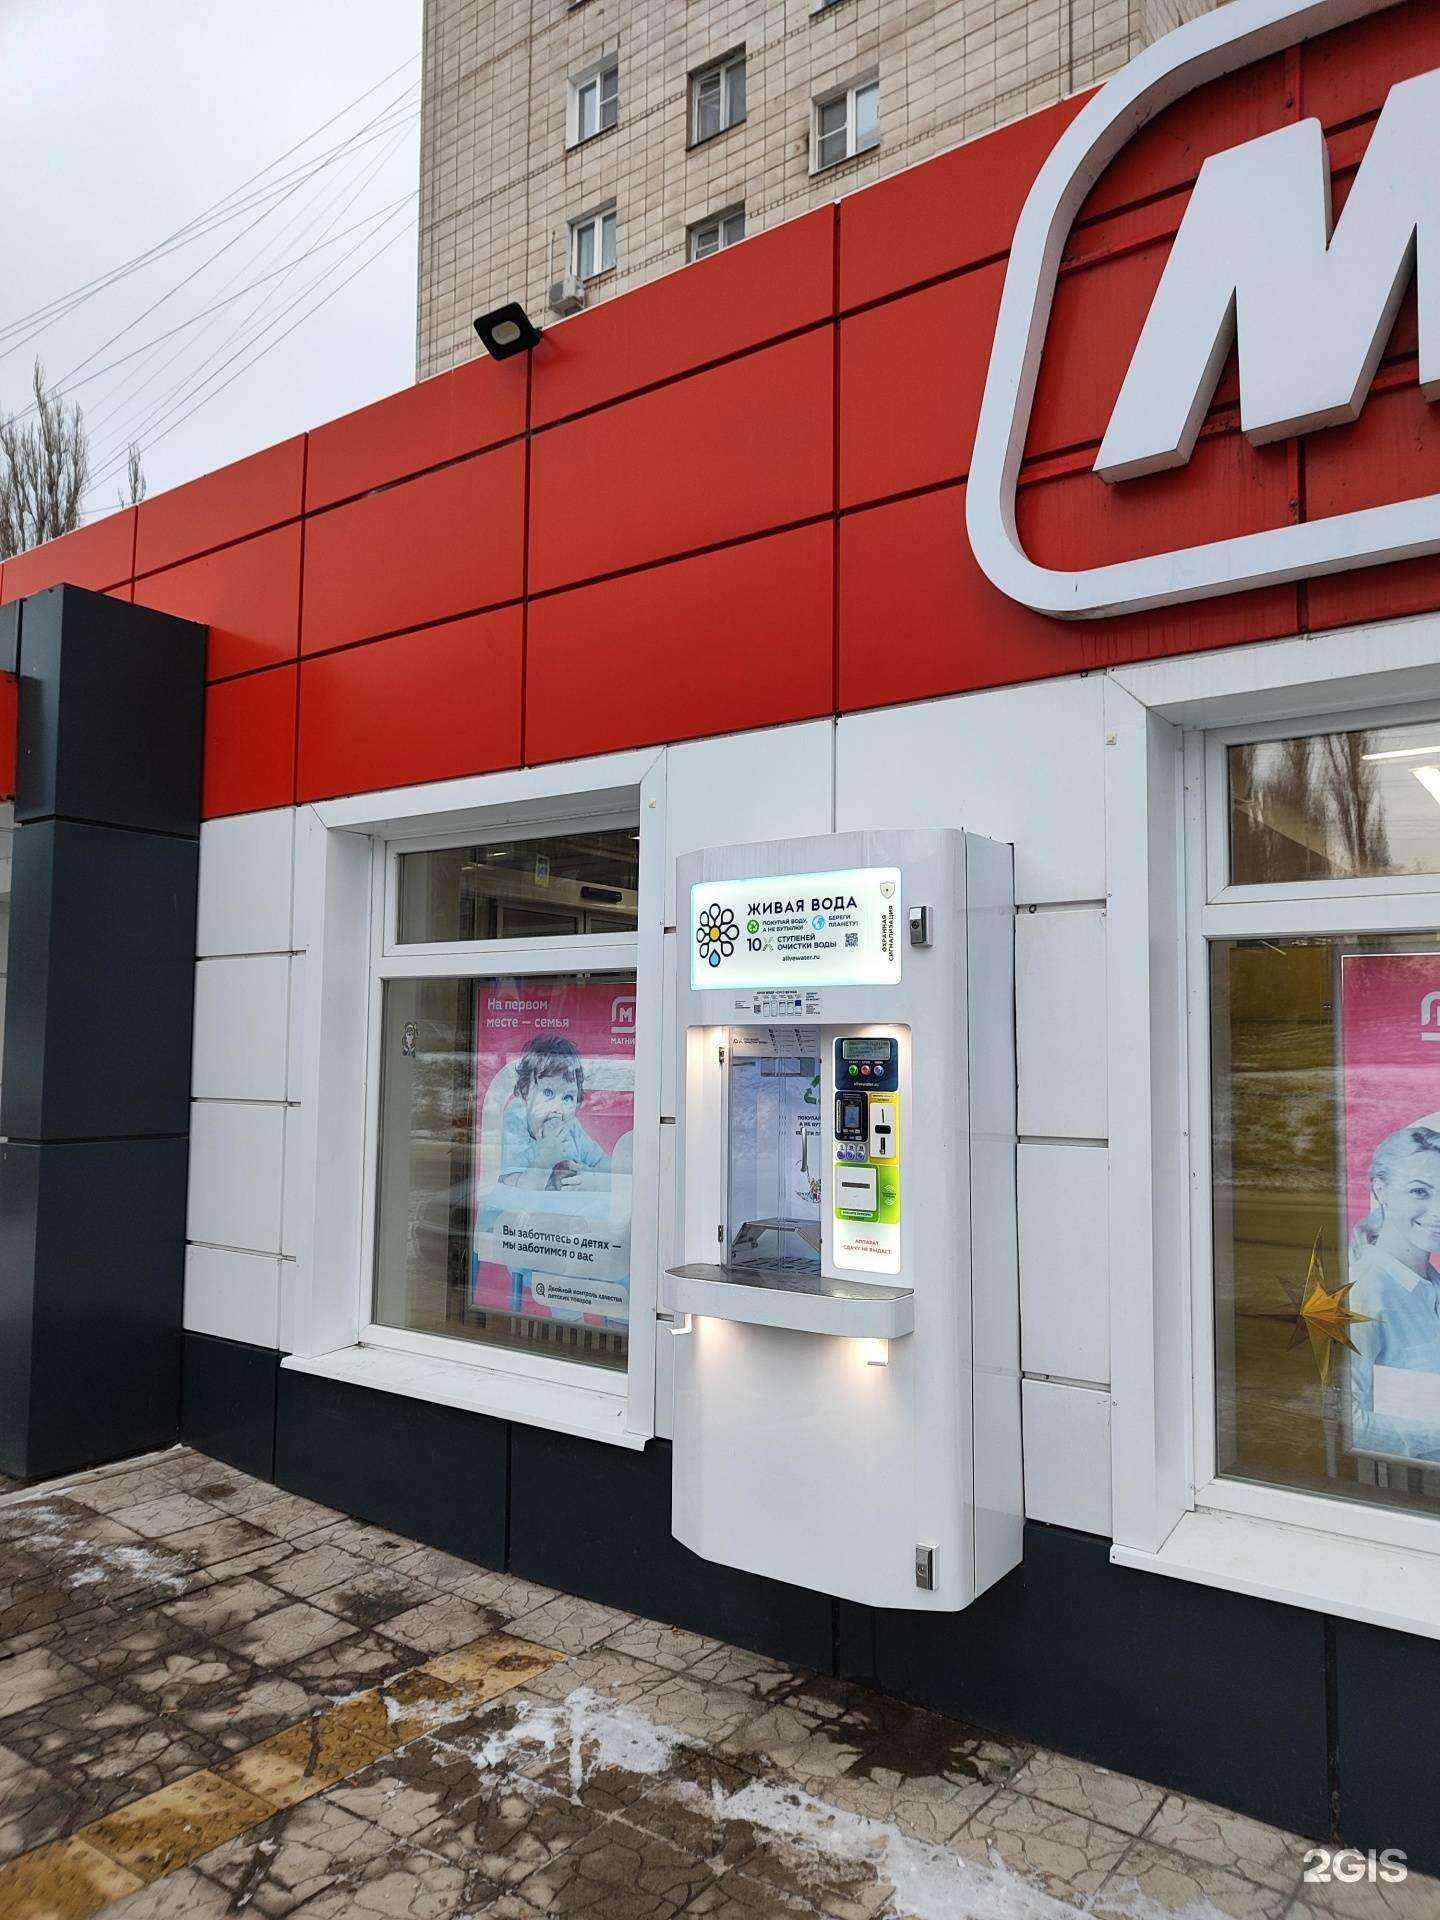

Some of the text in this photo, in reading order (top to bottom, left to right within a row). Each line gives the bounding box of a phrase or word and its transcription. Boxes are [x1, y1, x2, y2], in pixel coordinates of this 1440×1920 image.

[747, 896, 858, 916] ЖИВАЯ ВОДА
[776, 924, 804, 932] БУТЫЛКИ
[777, 932, 816, 943] СТУПЕНЕЙ
[777, 940, 837, 951] ОЧИСТКИ ВОДЫ
[487, 997, 549, 1012] На первом
[486, 1017, 519, 1028] месте
[534, 1017, 570, 1028] семья
[502, 1225, 516, 1238] Вы
[517, 1229, 572, 1244] заботитесь
[573, 1236, 580, 1246] о
[580, 1238, 610, 1250] детях
[855, 1238, 880, 1246] АППАРАТ
[502, 1240, 594, 1262] мы заботимся о вас
[842, 1244, 860, 1252] СДАЧУ
[547, 1284, 623, 1303] Двойной контроль качества
